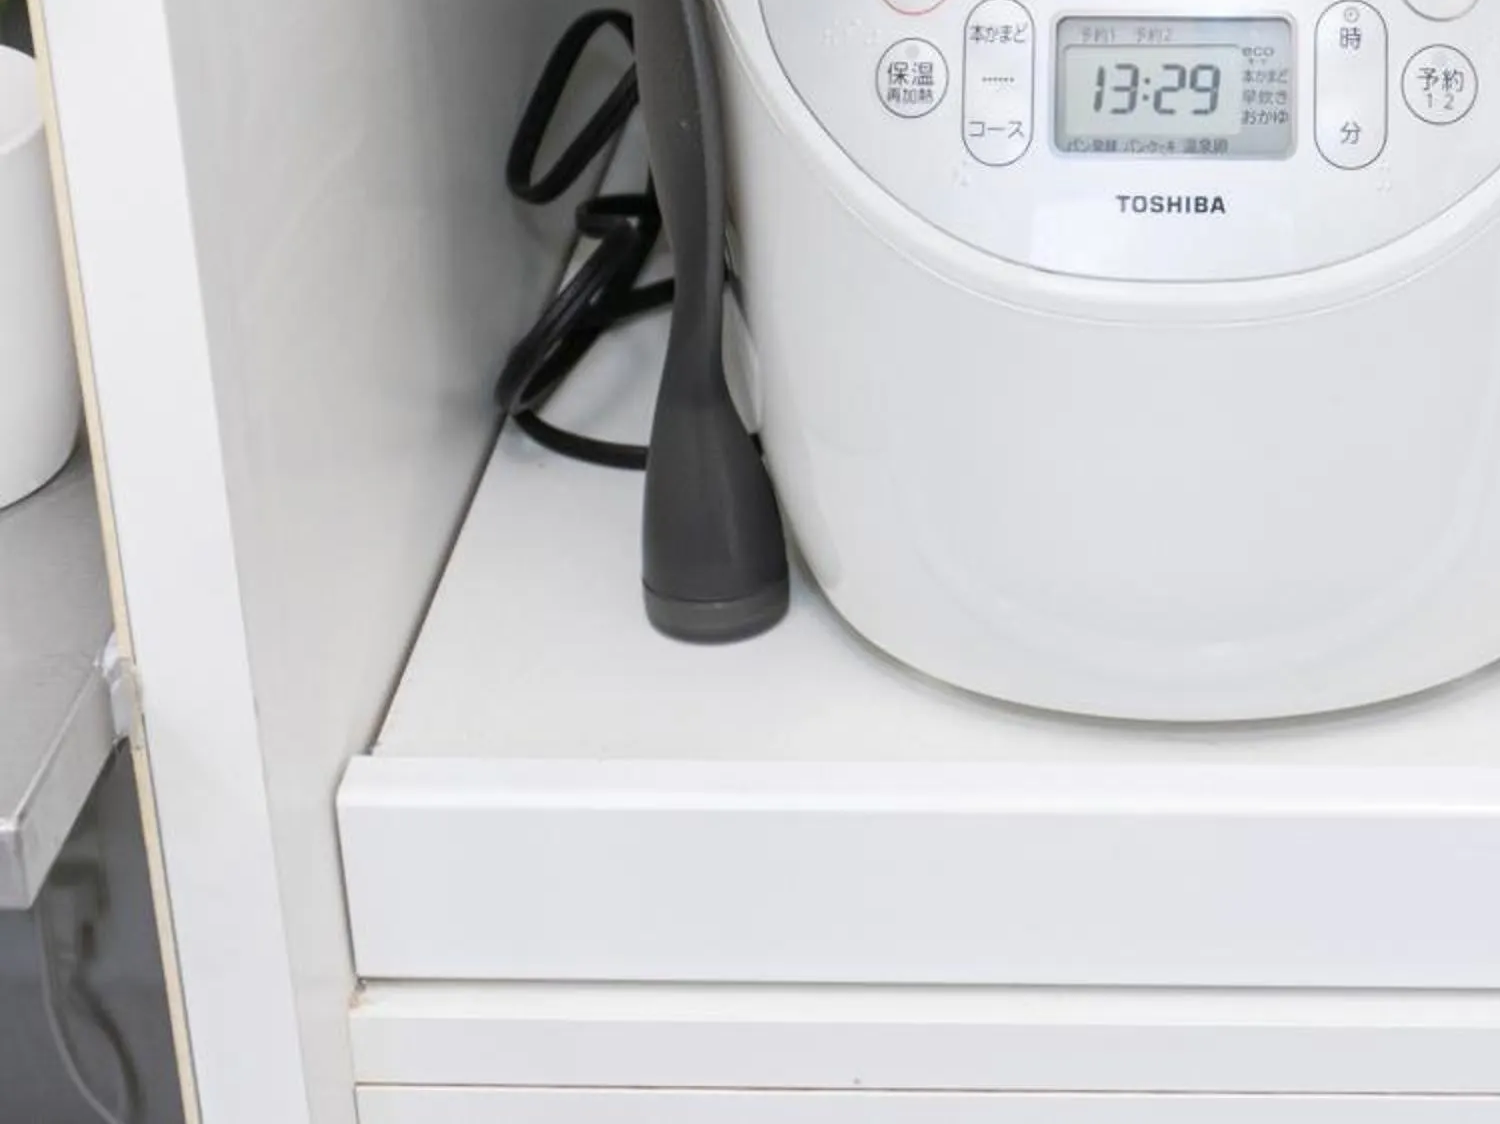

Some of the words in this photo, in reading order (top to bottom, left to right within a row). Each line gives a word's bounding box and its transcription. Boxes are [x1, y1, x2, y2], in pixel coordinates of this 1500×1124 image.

[969, 23, 1028, 44] 本かまど
[1339, 27, 1361, 50] 時
[887, 61, 935, 86] 保温
[1416, 67, 1465, 93] 予約
[887, 87, 935, 104] 再加熱
[1093, 63, 1221, 115] 13:29
[1426, 93, 1434, 108] 1
[1443, 93, 1456, 109] 2
[968, 121, 1025, 138] コース
[1340, 121, 1361, 144] 分
[1116, 194, 1226, 214] TOSHIBA
